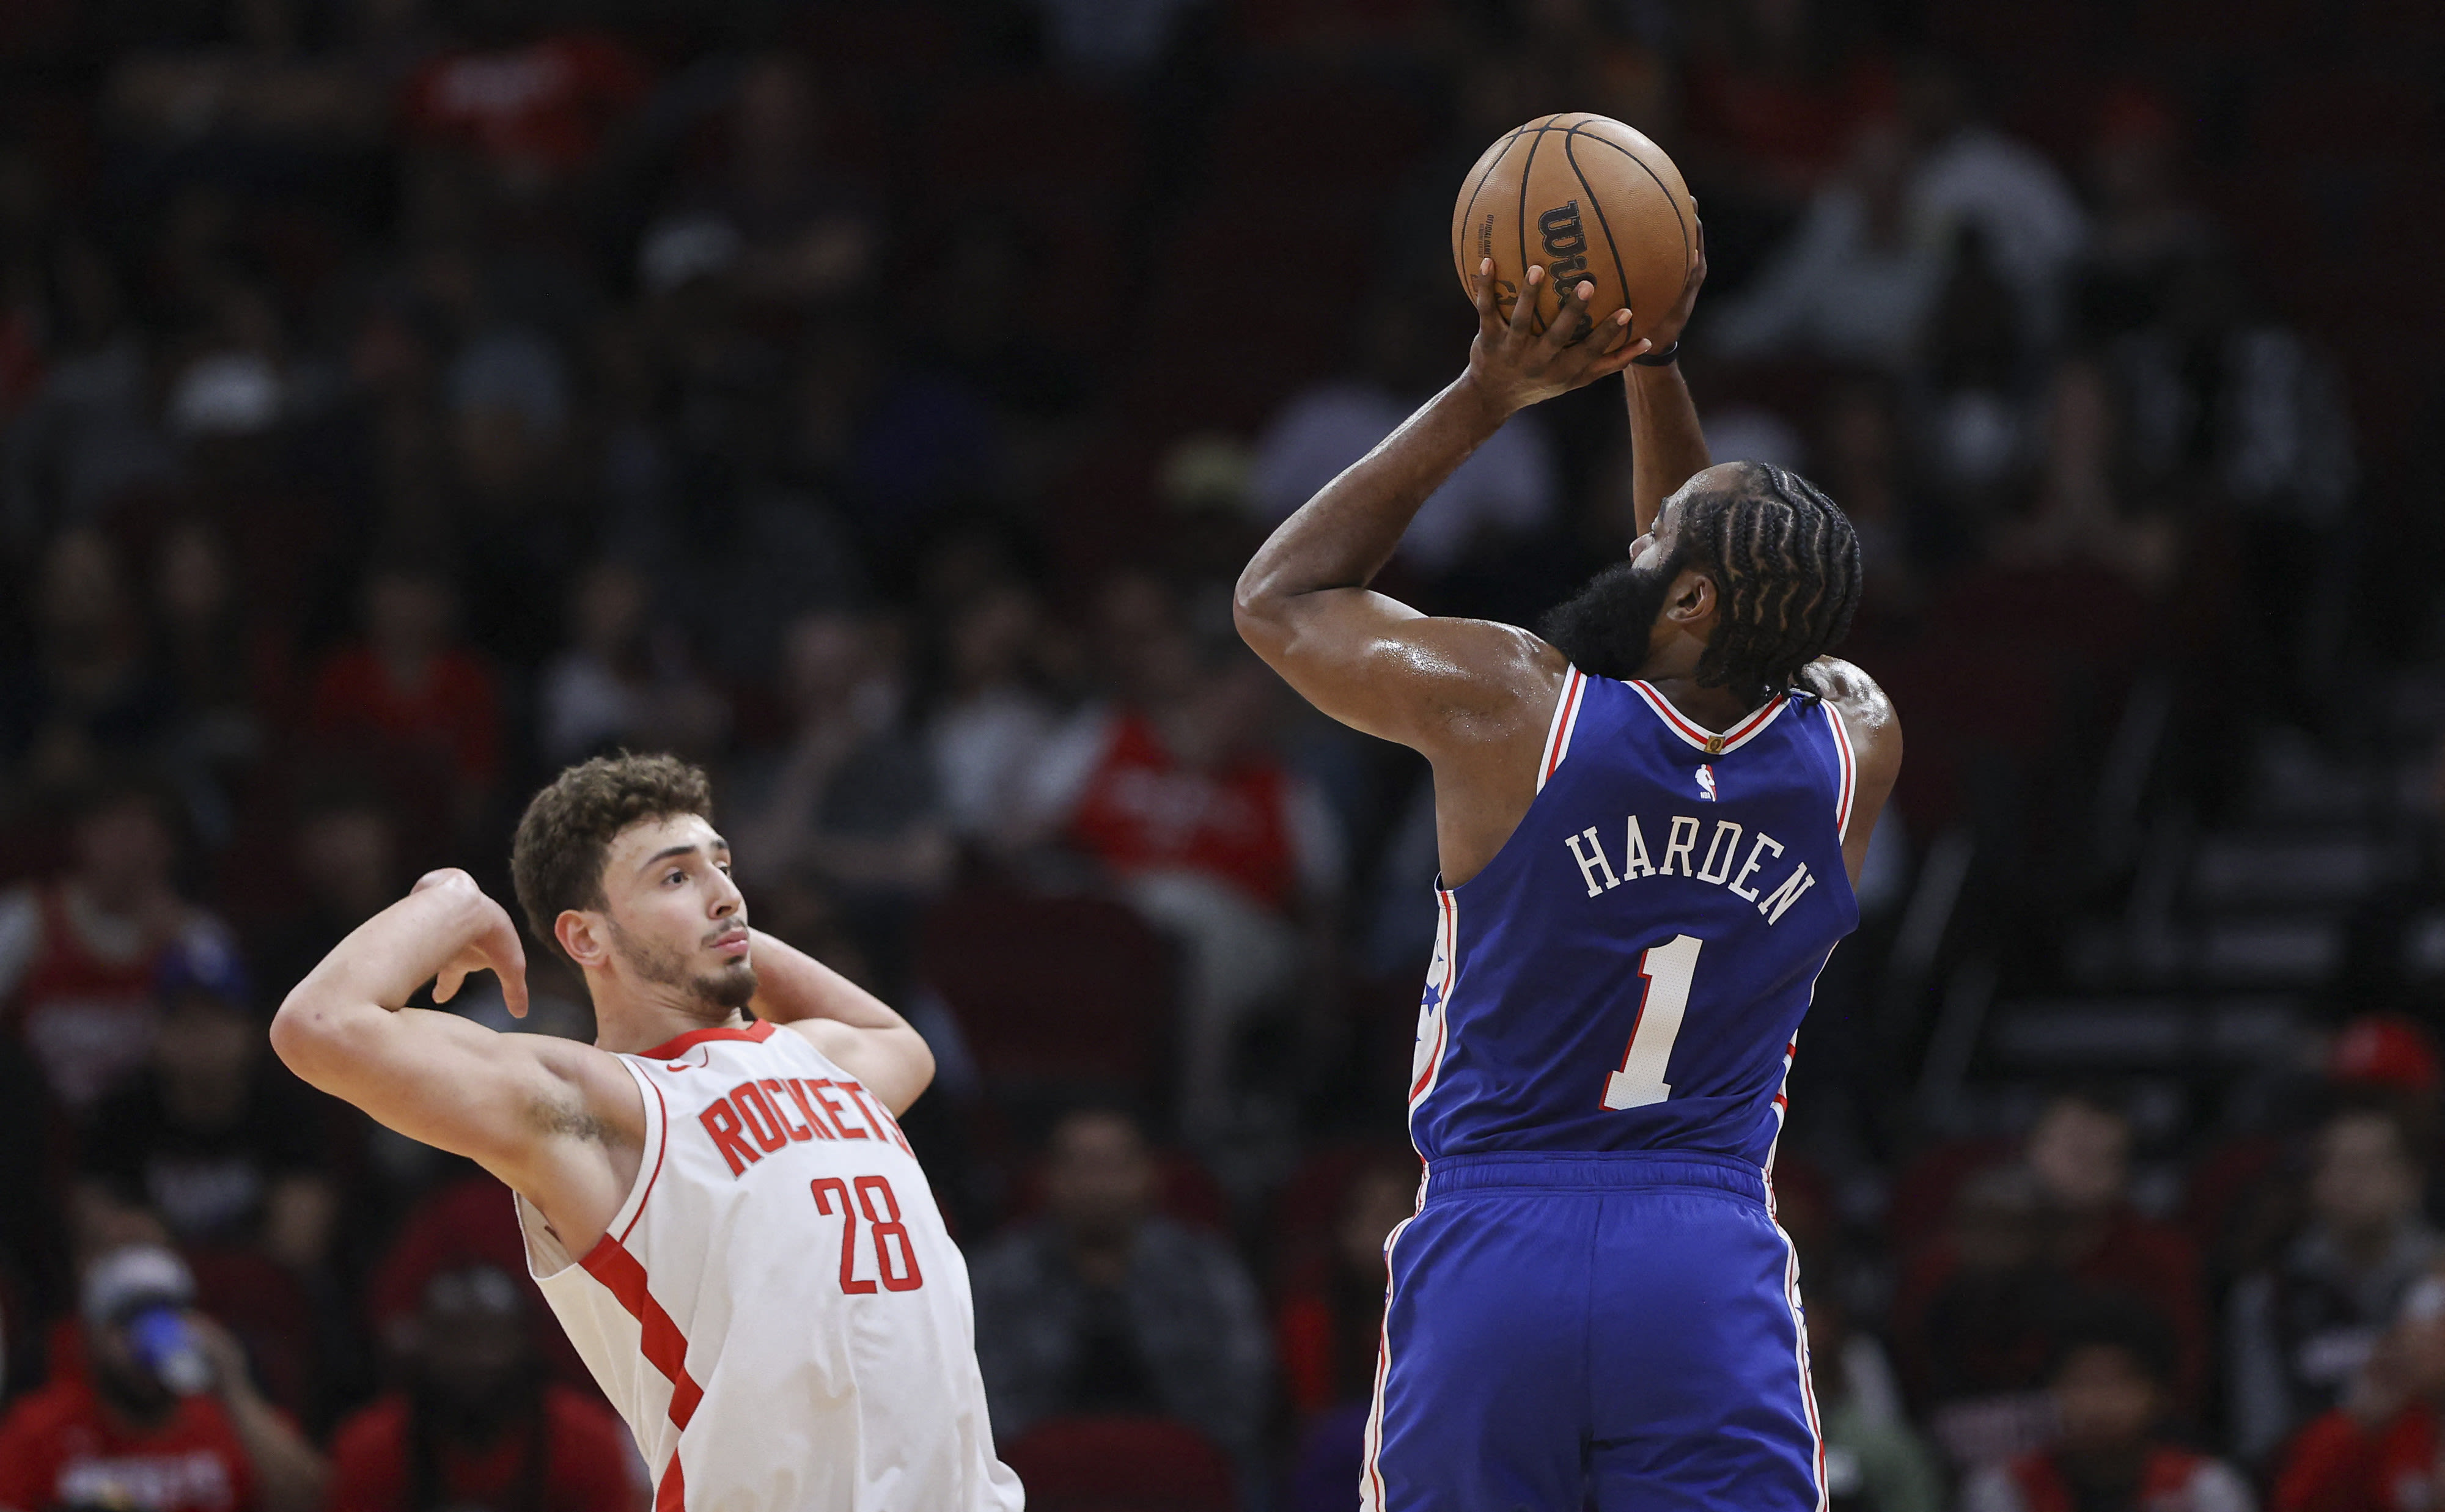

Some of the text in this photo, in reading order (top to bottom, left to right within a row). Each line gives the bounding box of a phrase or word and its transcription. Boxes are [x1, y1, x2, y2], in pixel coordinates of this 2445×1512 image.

[1484, 214, 1494, 238] OFFICIAL
[1538, 199, 1597, 342] Wil
[1565, 815, 1815, 926] HARDEN
[1598, 934, 1703, 1111] 1
[811, 1175, 924, 1294] 28
